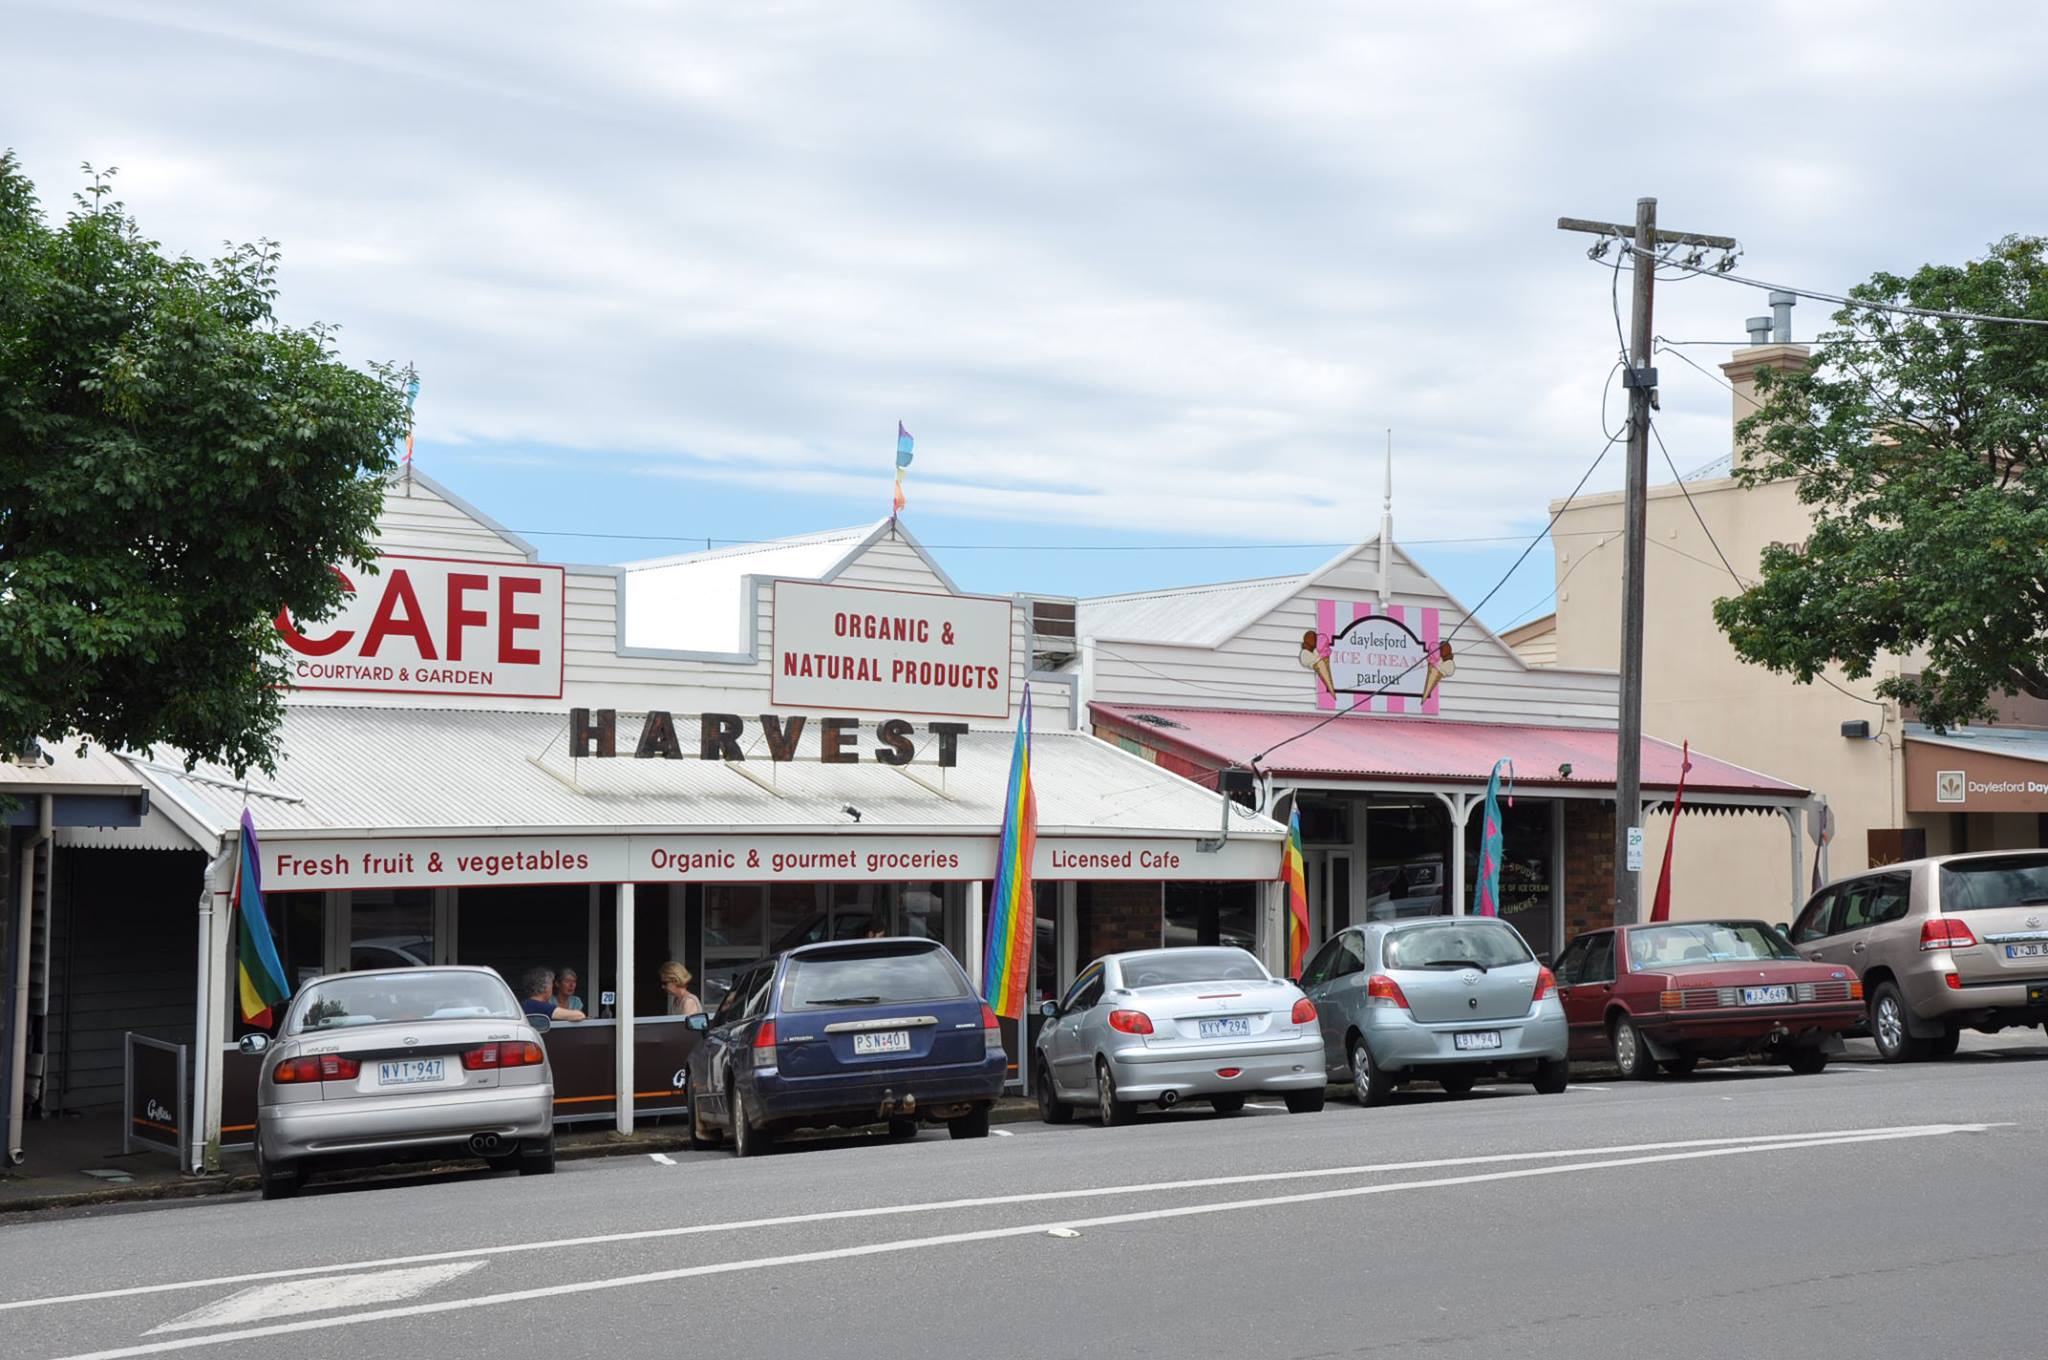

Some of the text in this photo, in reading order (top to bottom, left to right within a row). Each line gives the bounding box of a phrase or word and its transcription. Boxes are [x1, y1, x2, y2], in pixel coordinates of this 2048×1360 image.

[272, 565, 542, 665] CAFE
[834, 612, 955, 645] ORGANIC &
[1350, 631, 1407, 650] daylesford
[1333, 651, 1361, 664] ICE
[296, 663, 494, 686] COURTYARD & GARDEN
[783, 651, 999, 690] NATURAL PRODUCTS
[1356, 670, 1401, 687] parlour
[569, 707, 970, 768] HARVEST
[1968, 781, 2025, 795] Daylesford
[276, 850, 589, 876] Fresh fruit & vegetables
[650, 848, 959, 873] Organic & gourmet groceries
[1052, 850, 1180, 868] Licensed Cafe
[1503, 893, 1538, 914] LUNCHES
[603, 993, 614, 1003] 20
